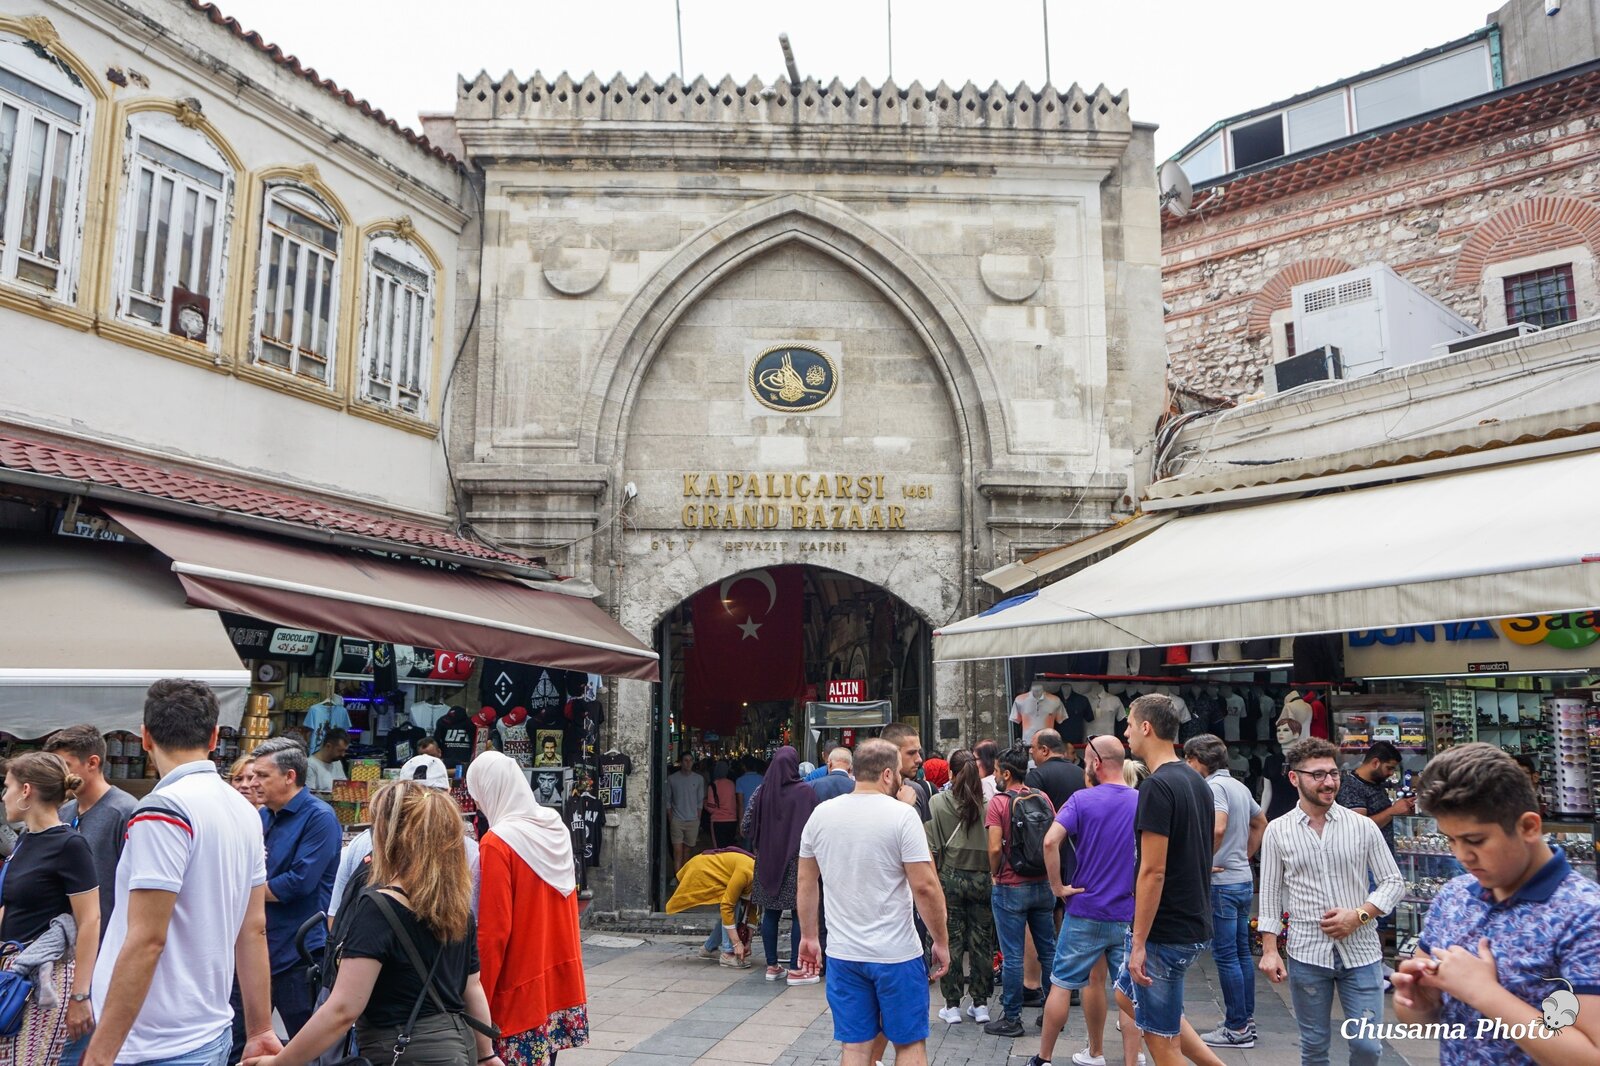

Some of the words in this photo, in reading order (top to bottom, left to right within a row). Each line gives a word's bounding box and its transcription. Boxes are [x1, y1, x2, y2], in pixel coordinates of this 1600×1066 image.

[902, 484, 933, 499] 1461
[682, 504, 780, 529] GRAND
[791, 504, 907, 529] BAZAAR
[800, 541, 848, 553] KAPISI
[276, 632, 315, 644] CHOCOLATE
[829, 682, 859, 695] ALTIN
